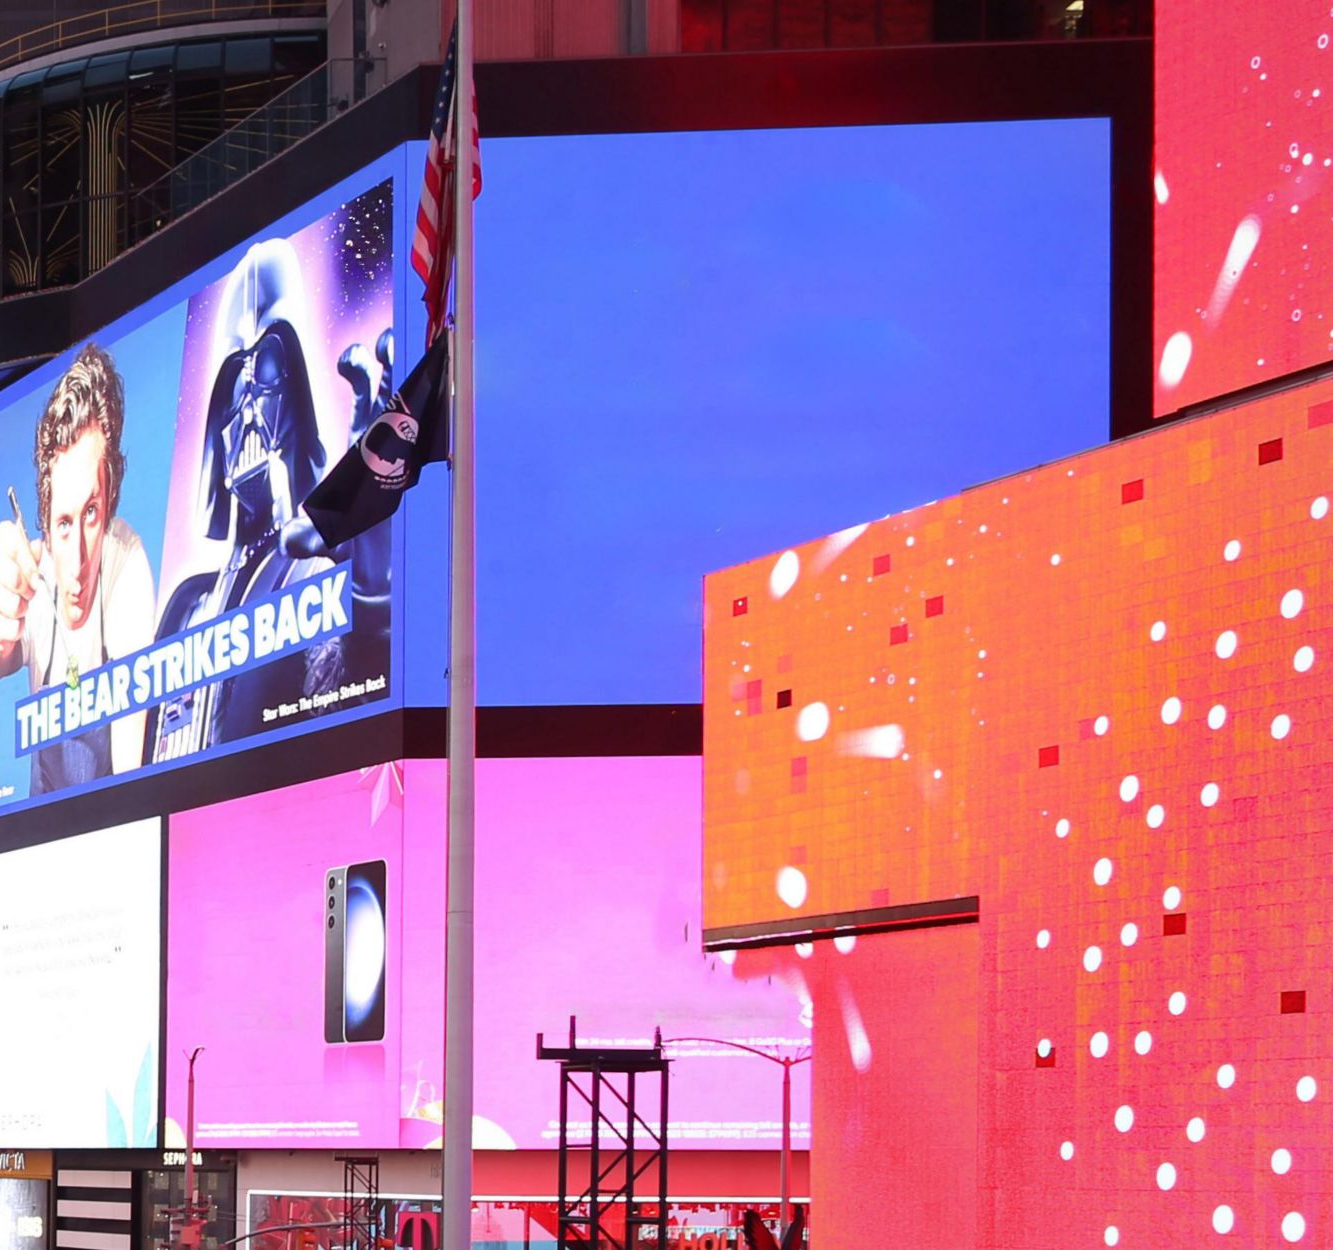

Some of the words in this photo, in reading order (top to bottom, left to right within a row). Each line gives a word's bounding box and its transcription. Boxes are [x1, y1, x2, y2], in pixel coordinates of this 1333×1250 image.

[17, 691, 62, 749] THE
[64, 664, 131, 733] BEAR
[133, 612, 250, 705] STRIKES
[254, 570, 349, 660] BACK
[262, 706, 278, 723] Star
[278, 701, 298, 720] Wars:
[299, 697, 313, 712] The
[313, 691, 339, 712] Empire
[340, 683, 365, 702] Strikes
[366, 675, 386, 693] Back
